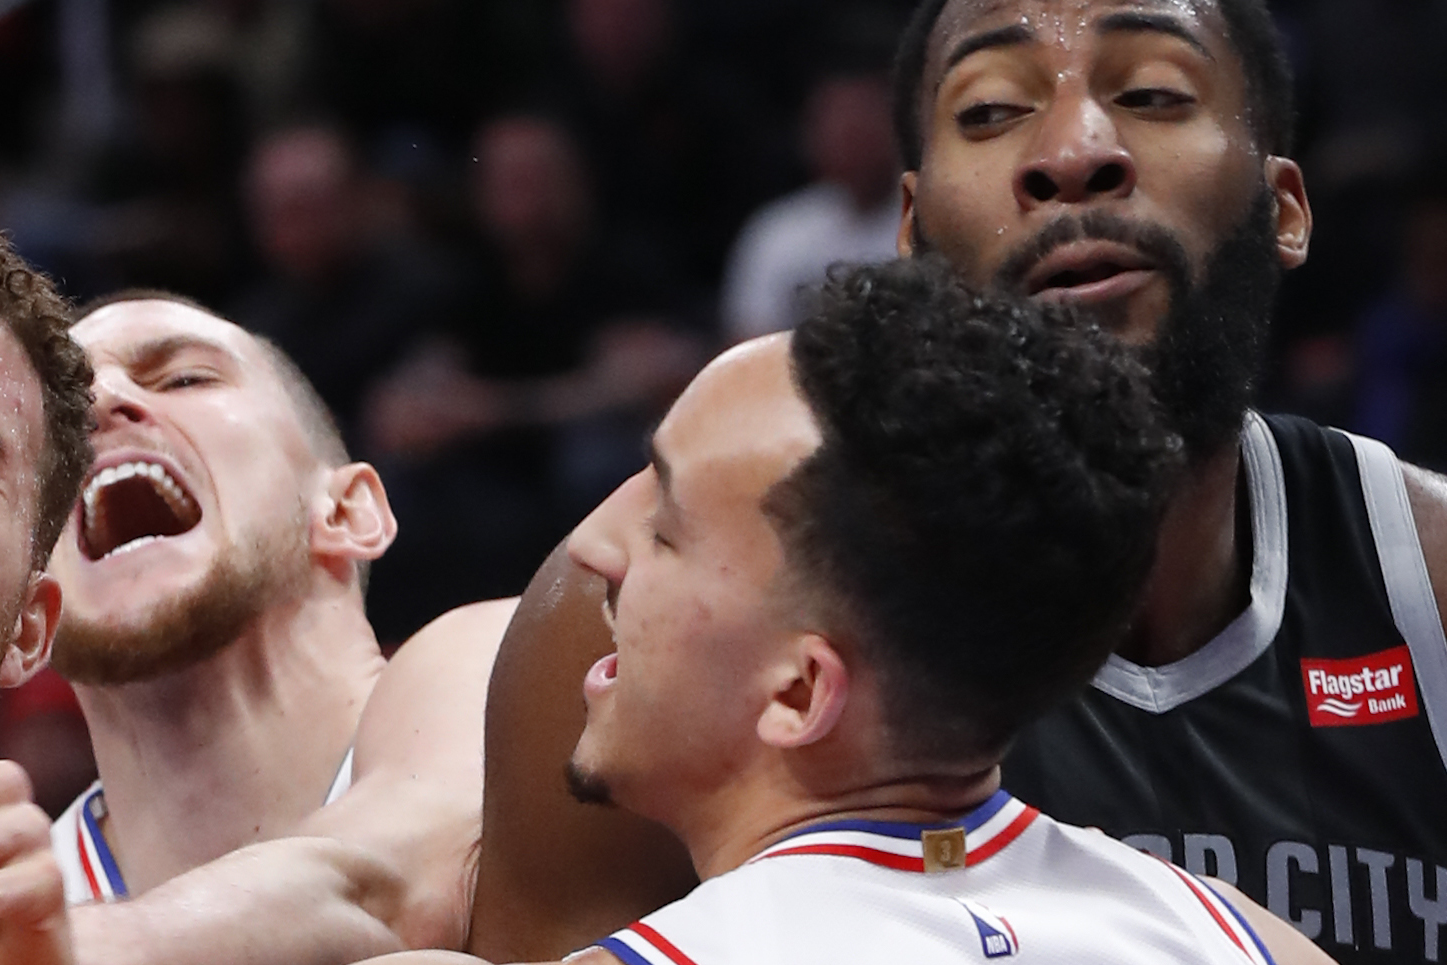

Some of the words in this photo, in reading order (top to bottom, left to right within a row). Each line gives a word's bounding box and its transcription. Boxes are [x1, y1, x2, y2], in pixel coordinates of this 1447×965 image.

[1307, 664, 1403, 700] Flagstar
[1367, 693, 1407, 715] Bank
[1265, 841, 1447, 963] CITY
[985, 934, 1009, 955] NBA
